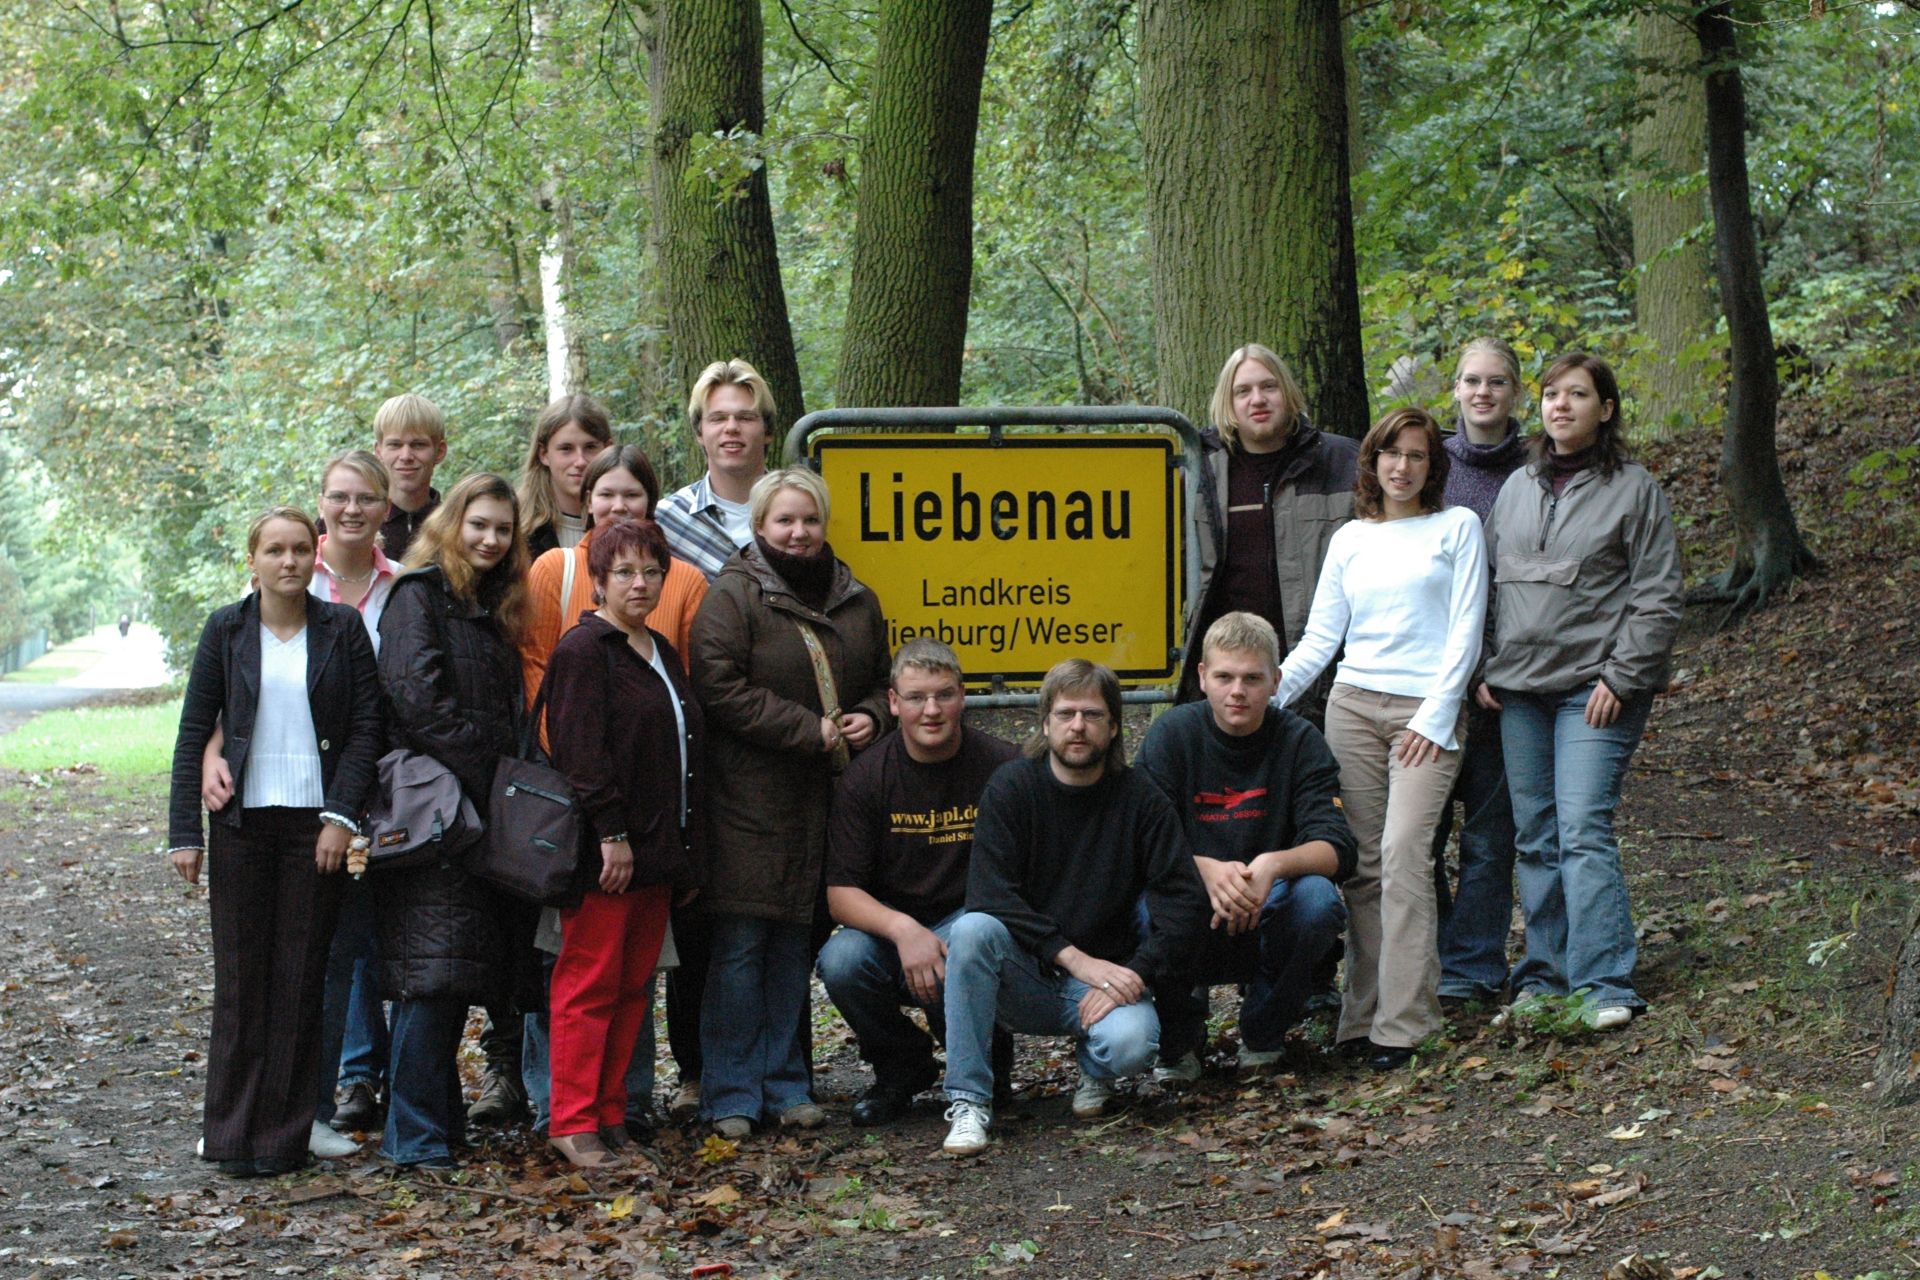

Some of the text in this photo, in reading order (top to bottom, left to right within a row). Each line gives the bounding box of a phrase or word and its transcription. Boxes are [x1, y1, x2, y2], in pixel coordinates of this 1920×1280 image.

[860, 472, 1131, 542] Liebenau
[922, 577, 1071, 607] Landkreis
[884, 617, 1123, 653] ienburg/Weser
